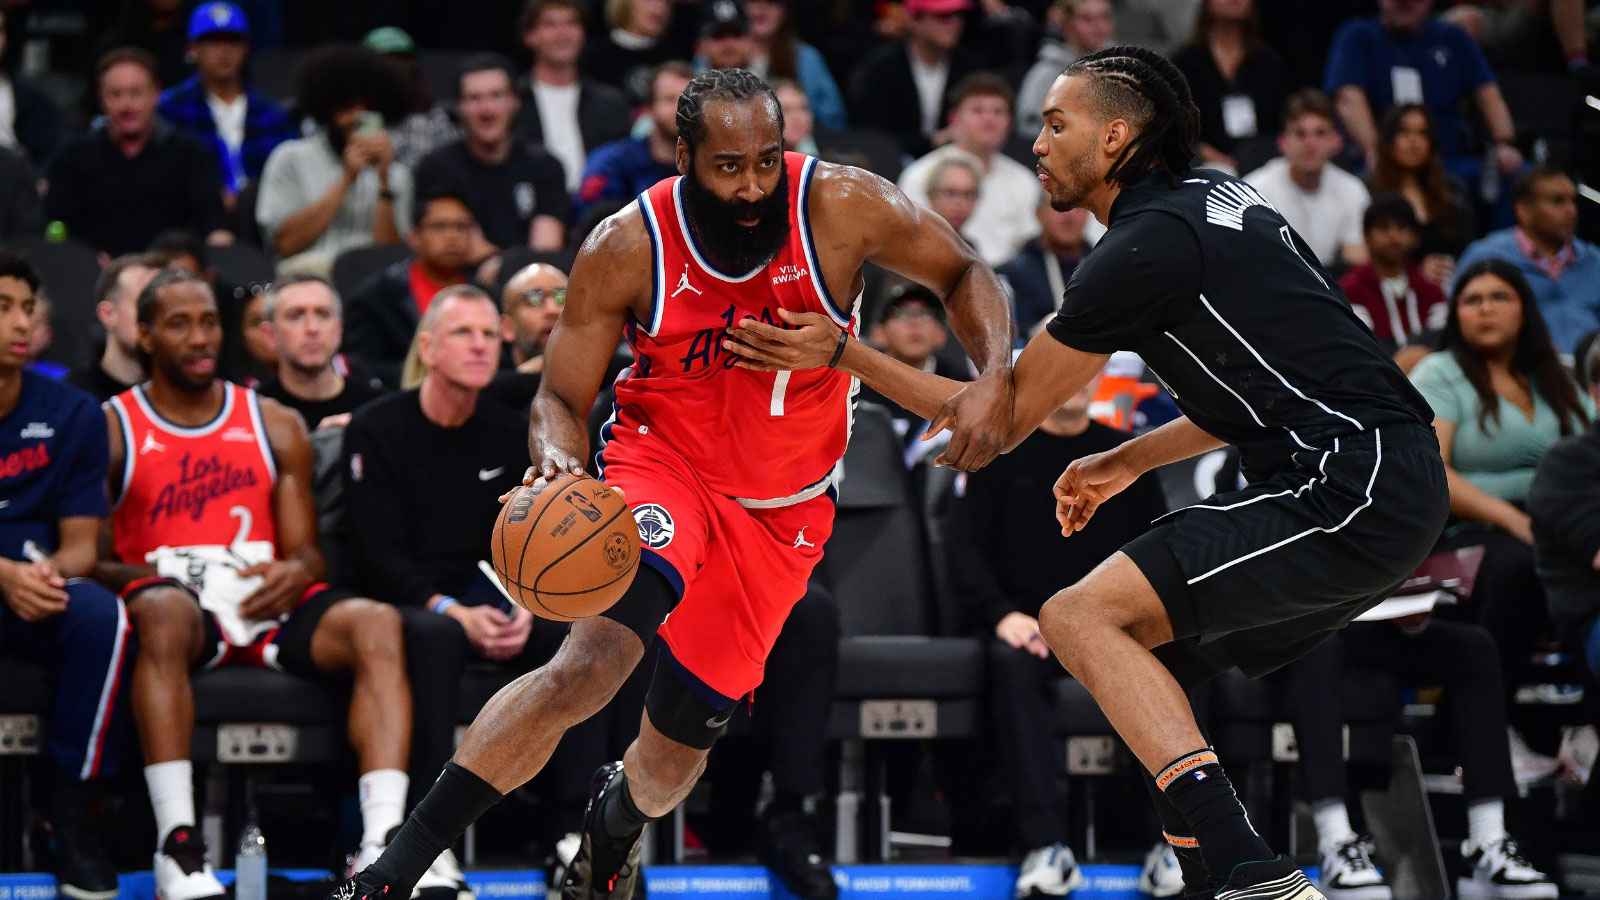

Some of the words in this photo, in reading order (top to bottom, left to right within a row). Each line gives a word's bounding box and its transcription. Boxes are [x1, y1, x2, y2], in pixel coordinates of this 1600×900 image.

[1206, 181, 1280, 232] WILLIAM
[779, 264, 799, 275] VISI
[179, 453, 223, 486] Los
[151, 459, 258, 521] Angeles
[229, 506, 251, 544] 2
